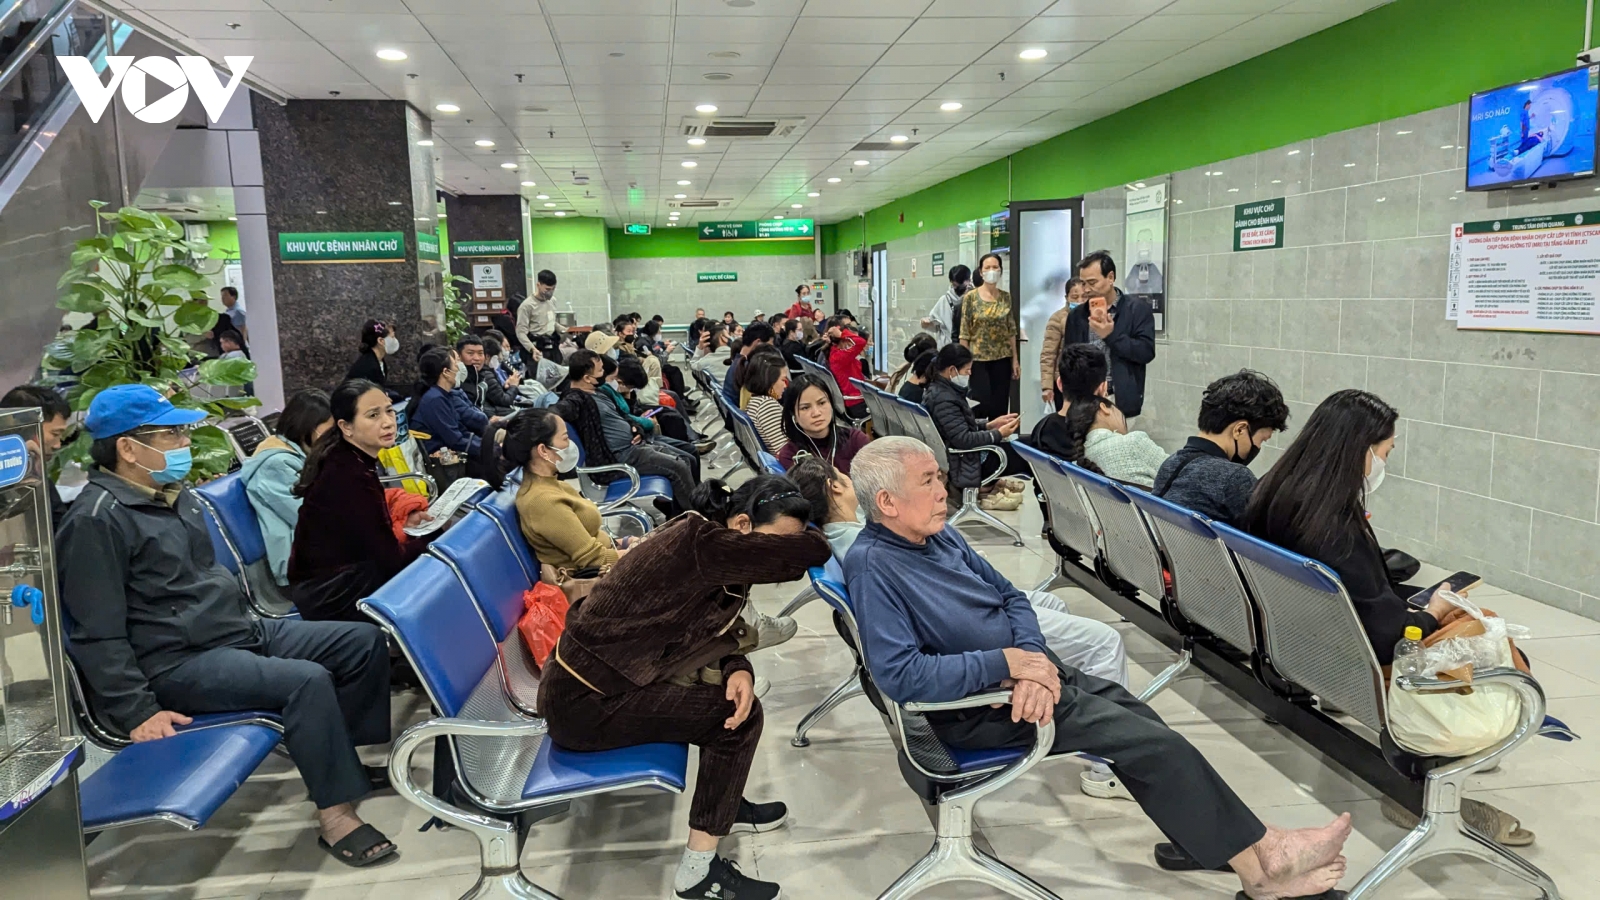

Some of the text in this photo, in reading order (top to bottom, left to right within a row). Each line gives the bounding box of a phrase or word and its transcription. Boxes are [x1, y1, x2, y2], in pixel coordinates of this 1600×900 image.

[1472, 112, 1484, 121] MRI
[1254, 205, 1264, 215] VỰC
[1264, 203, 1275, 212] CHỜ
[1235, 220, 1248, 228] DÀNH
[1258, 216, 1269, 226] BỆNH
[1270, 214, 1284, 223] NHÂN
[286, 239, 398, 254] KHU VỰC BỆNH NHÂN CHỜ
[468, 245, 478, 253] VỰC
[479, 245, 491, 253] BỆNH
